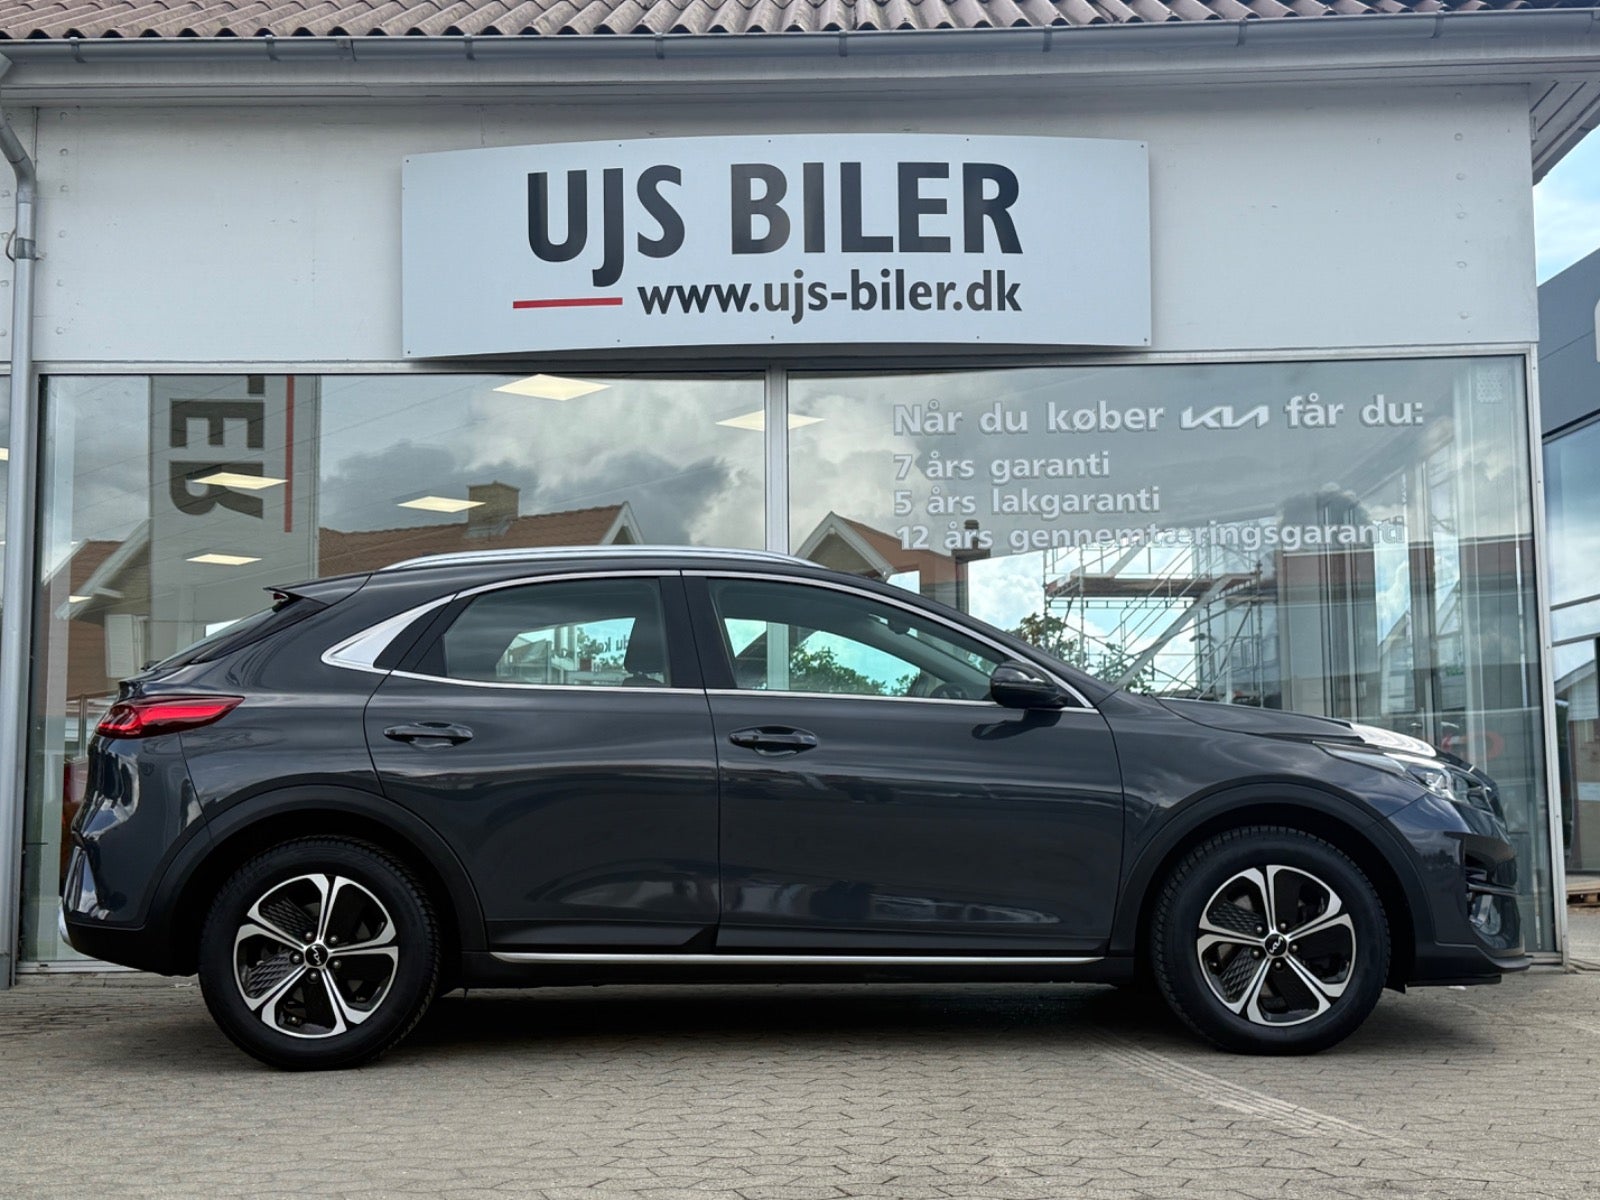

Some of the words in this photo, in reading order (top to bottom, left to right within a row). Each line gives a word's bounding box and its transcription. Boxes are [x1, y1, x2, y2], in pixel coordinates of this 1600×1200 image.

[526, 165, 686, 287] UJS
[731, 161, 1023, 255] BILER
[637, 268, 1022, 324] www.ujs-biler.dk
[893, 399, 963, 436] Når
[978, 402, 1029, 434] du
[1047, 399, 1164, 433] køber
[1284, 392, 1344, 429] får
[1361, 393, 1424, 427] du:
[893, 454, 913, 480] 7
[925, 450, 975, 480] års
[989, 450, 1110, 485] garanti
[893, 490, 913, 516] 5
[926, 486, 976, 515] års
[991, 485, 1160, 519] lakgaranti
[896, 525, 930, 550] 12
[944, 521, 993, 549] års
[1009, 516, 1406, 554] gennemtæringsgaranti
